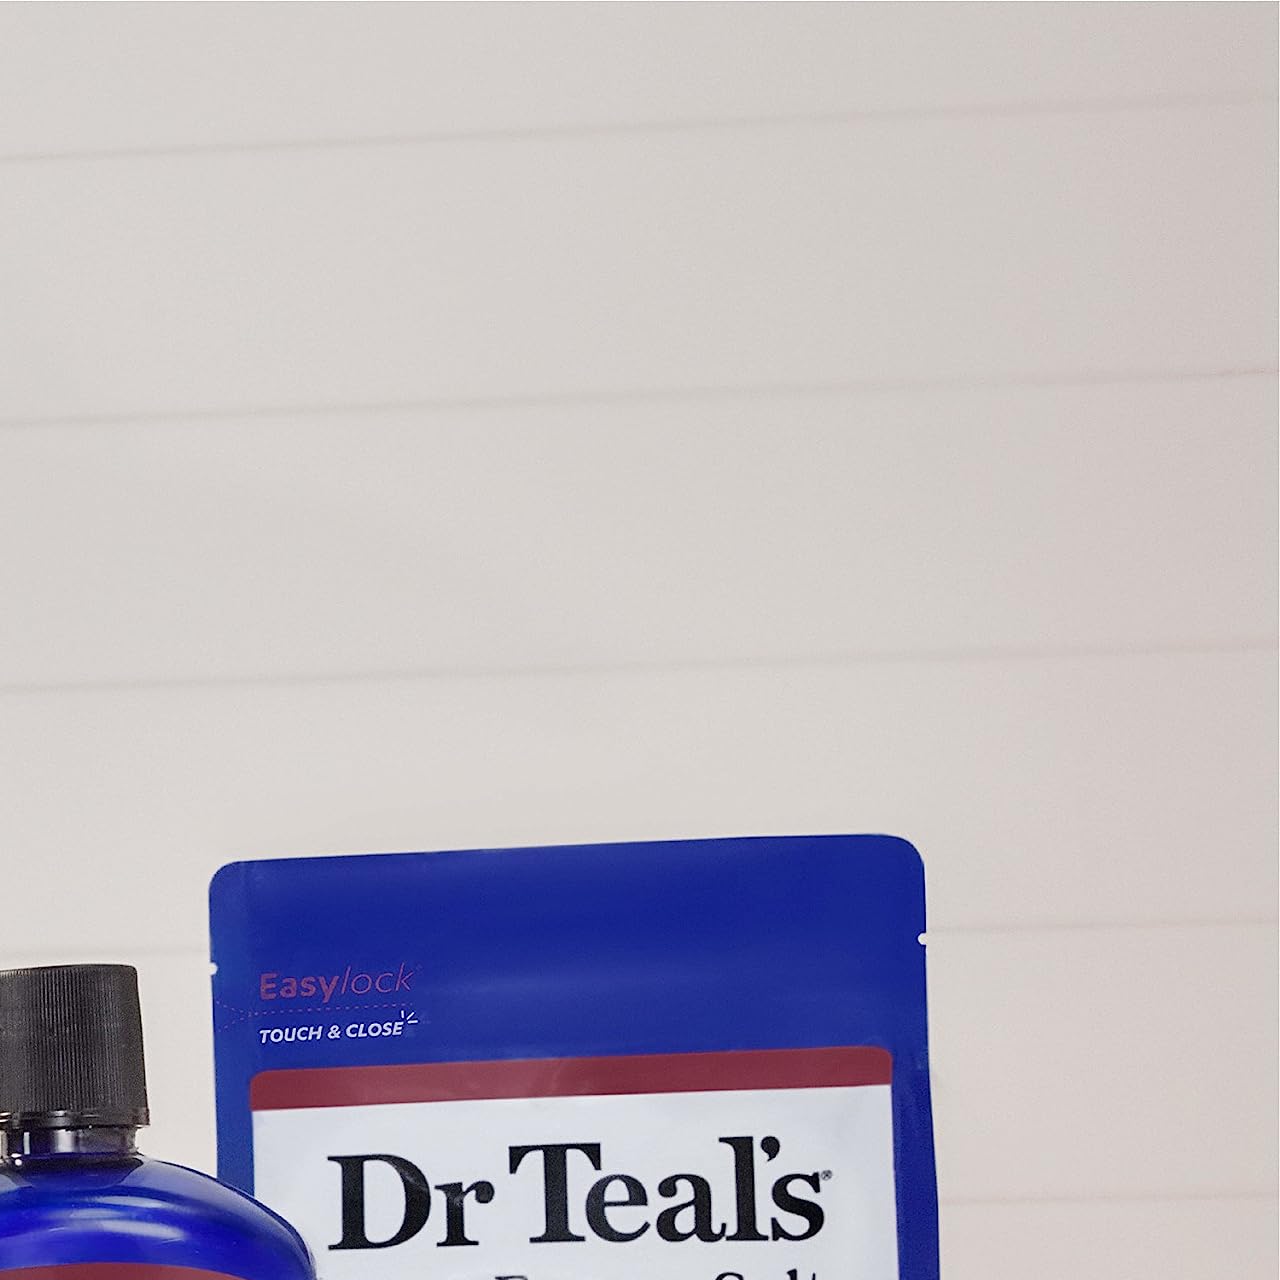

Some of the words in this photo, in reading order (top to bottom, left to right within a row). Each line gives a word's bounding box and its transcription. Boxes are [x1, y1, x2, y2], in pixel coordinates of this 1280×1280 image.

[259, 962, 414, 1004] Easylock
[259, 1025, 323, 1044] TOUCH
[327, 1024, 341, 1040] &
[345, 1020, 404, 1039] CLOSE
[327, 1152, 495, 1251] Dr
